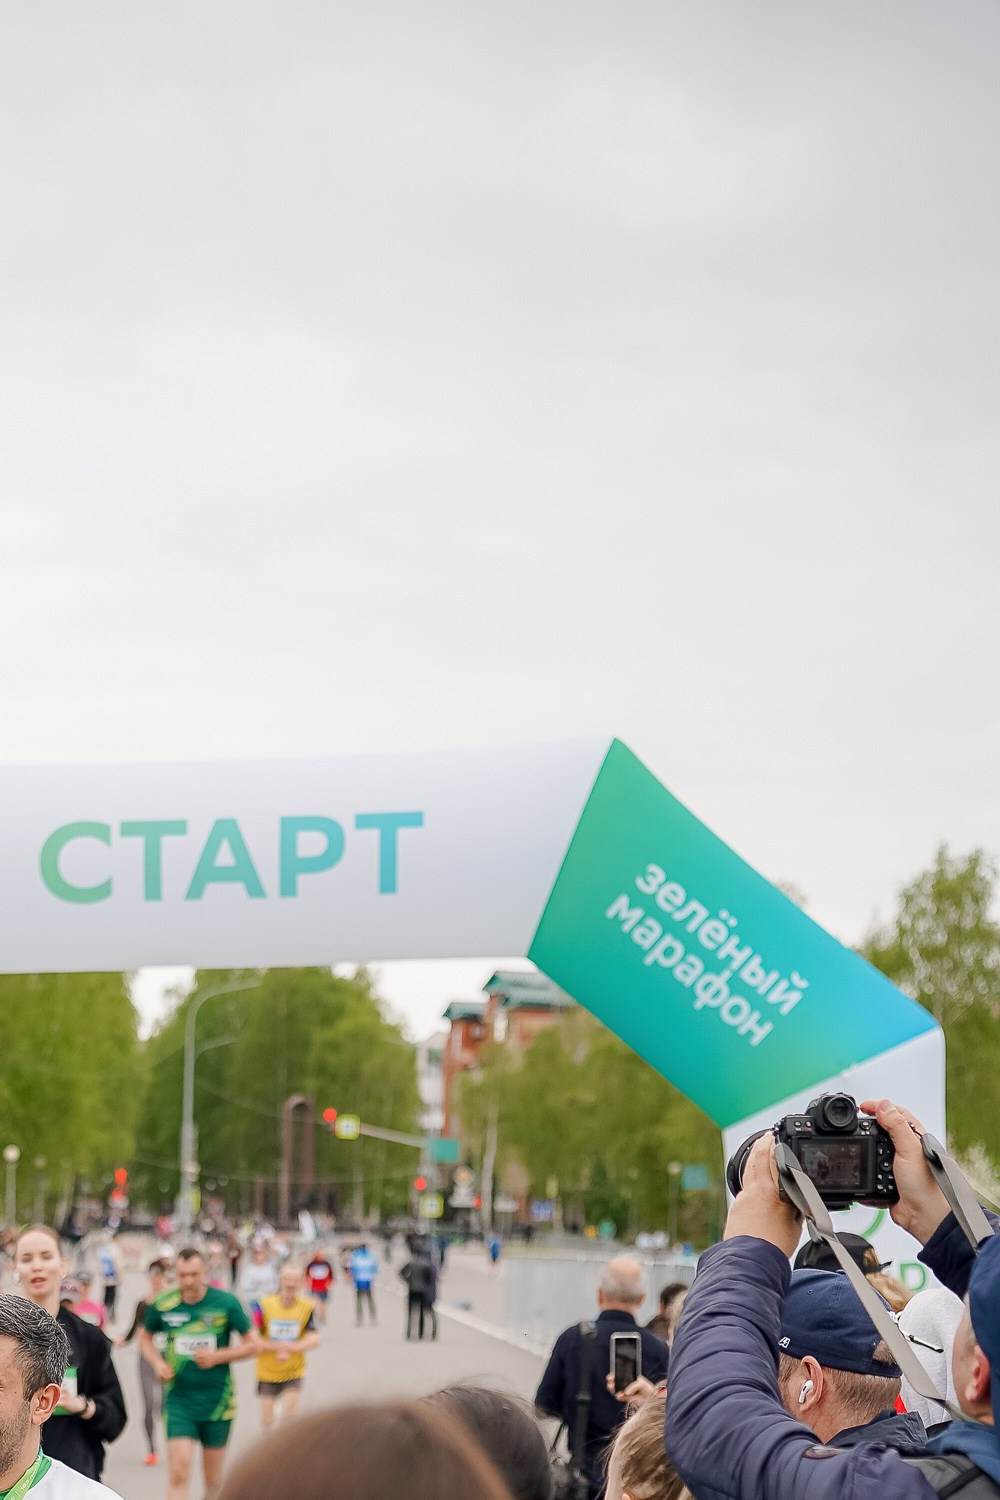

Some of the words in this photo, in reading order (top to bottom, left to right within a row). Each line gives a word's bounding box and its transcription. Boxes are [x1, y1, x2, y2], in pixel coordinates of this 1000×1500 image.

[39, 810, 424, 905] СТАРТ
[605, 892, 775, 1048] марафон
[634, 862, 810, 1017] зелёный
